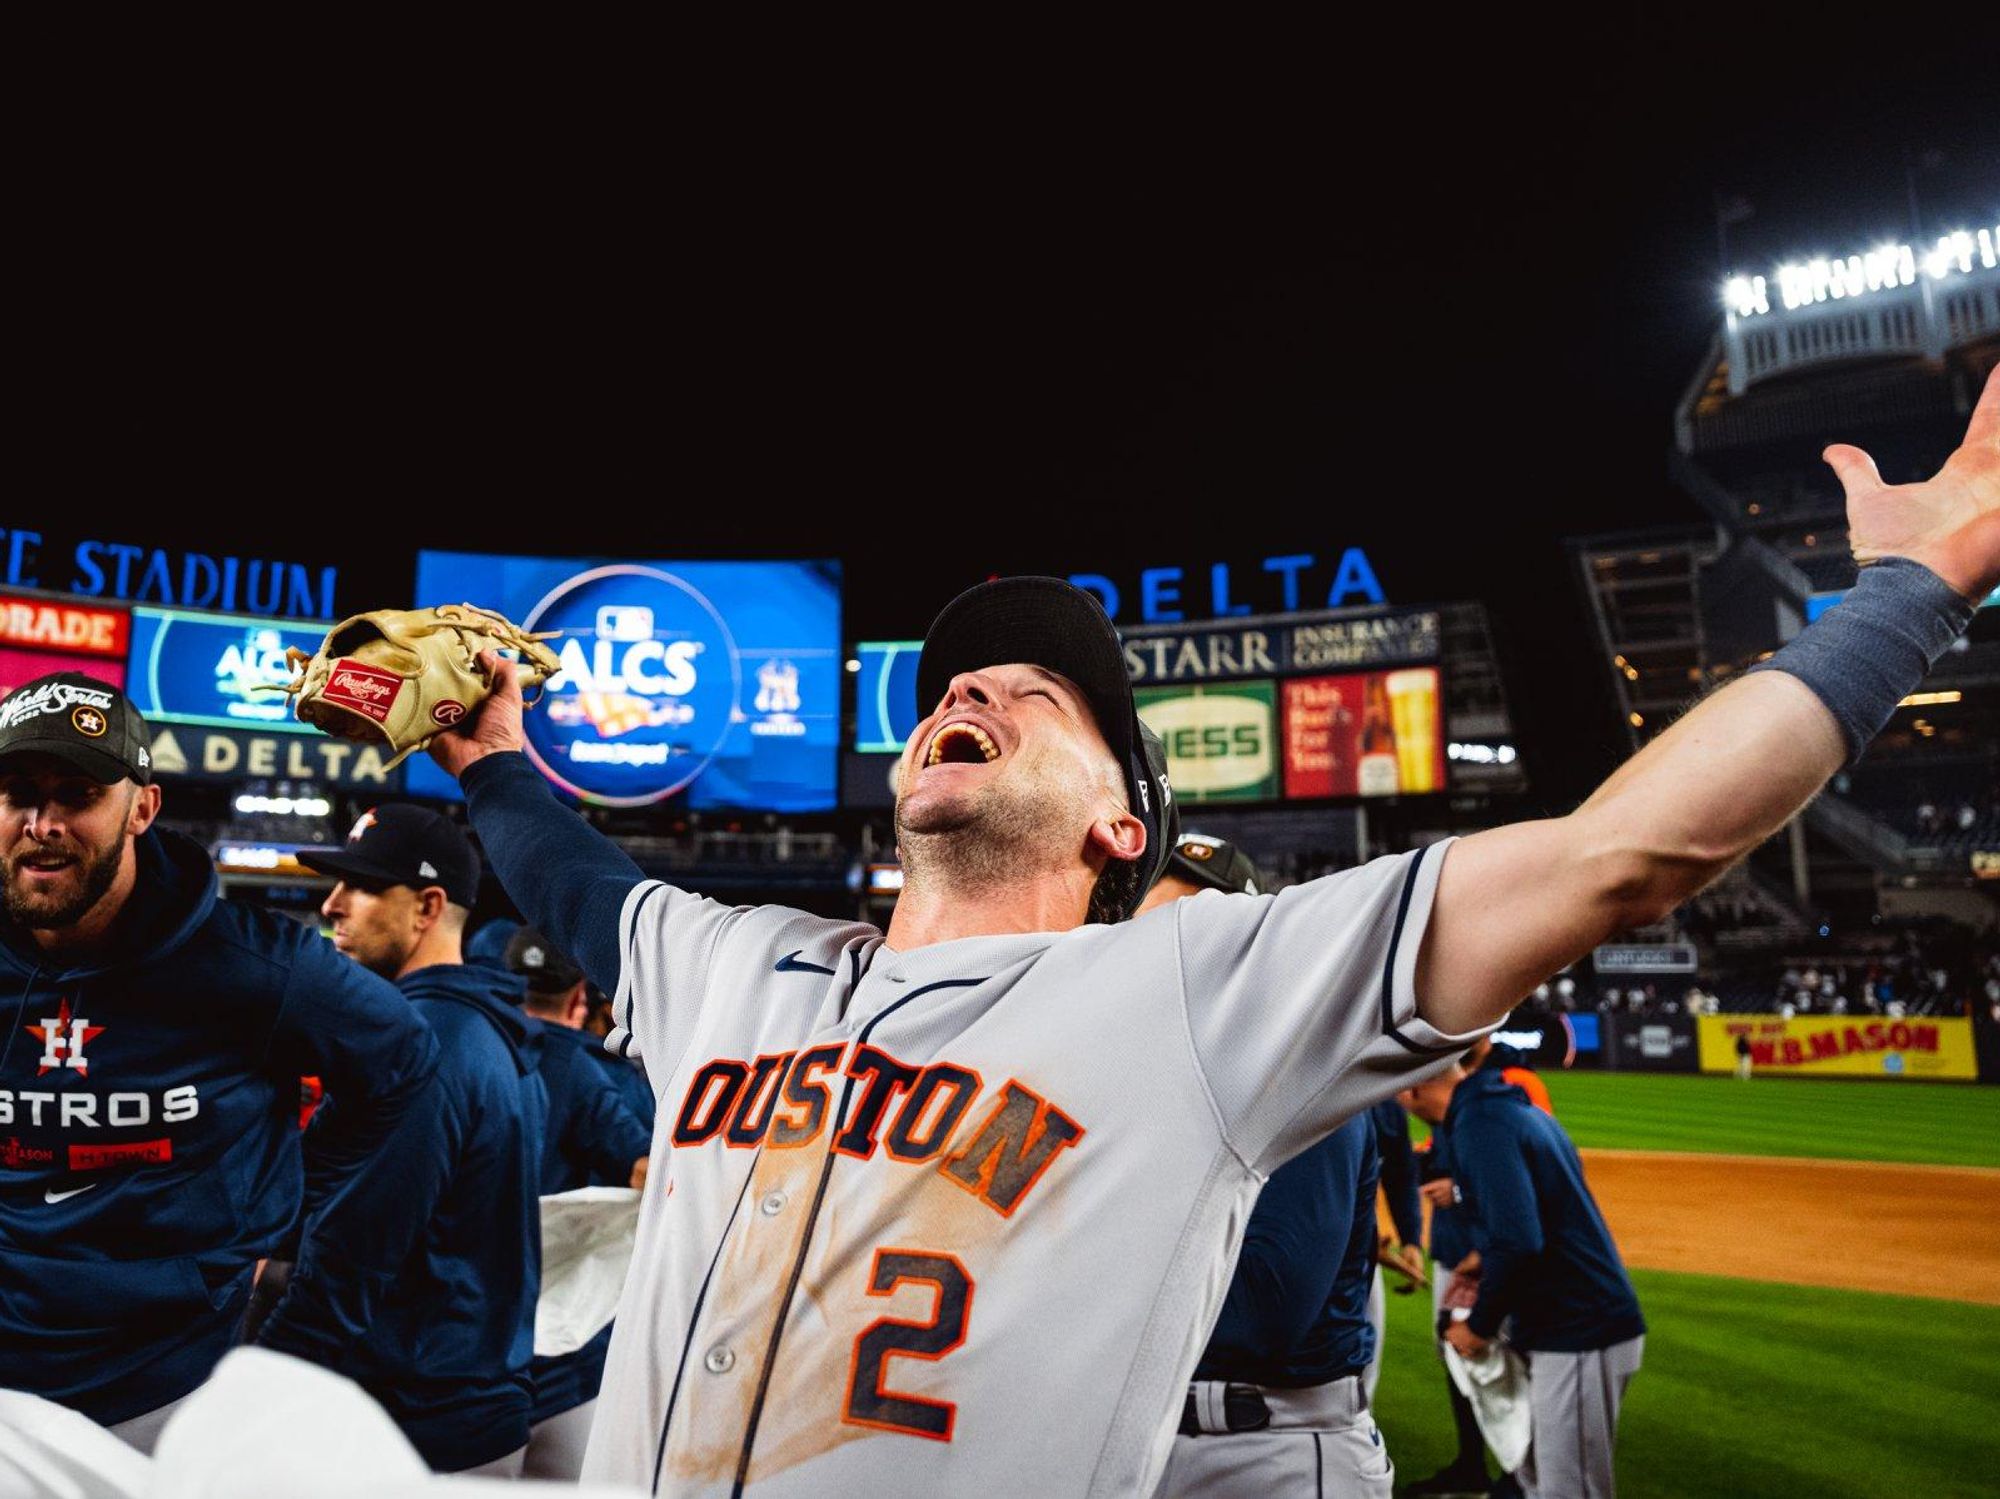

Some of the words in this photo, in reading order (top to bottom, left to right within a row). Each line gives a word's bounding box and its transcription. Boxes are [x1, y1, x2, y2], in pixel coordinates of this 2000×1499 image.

[0, 527, 42, 587] E
[69, 540, 337, 620] STADIUM
[1067, 547, 1387, 624] DELTA
[0, 604, 115, 649] RADE
[546, 638, 700, 697] ALCS
[1123, 630, 1275, 682] STARR
[40, 684, 114, 714] Series
[334, 672, 391, 699] Rawlings
[203, 734, 387, 784] DELTA
[39, 1018, 89, 1067] H
[671, 1042, 1086, 1219] OUSTON
[841, 1247, 975, 1444] 2
